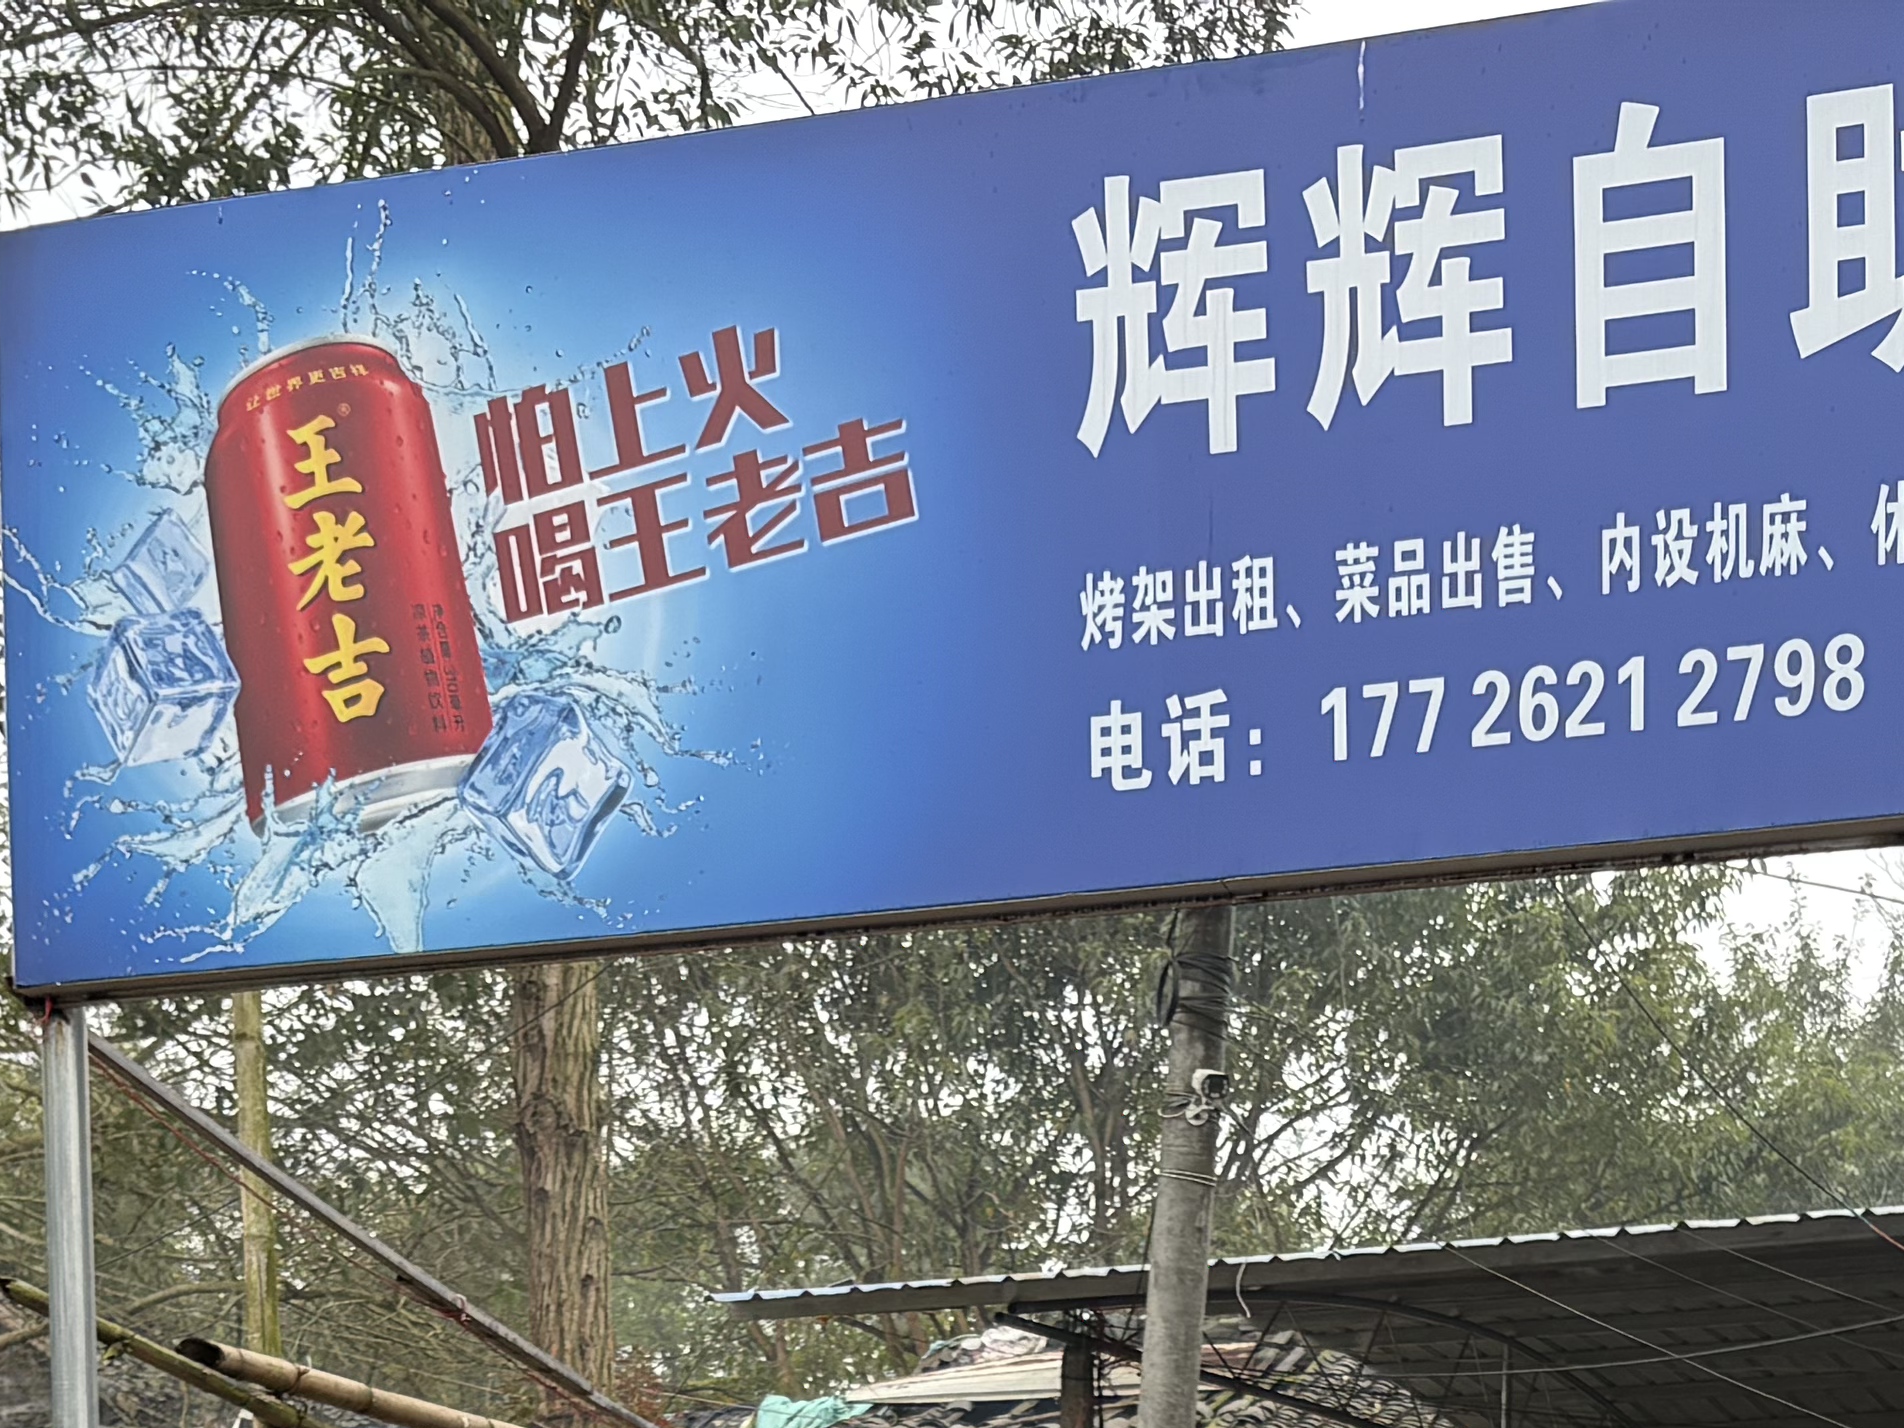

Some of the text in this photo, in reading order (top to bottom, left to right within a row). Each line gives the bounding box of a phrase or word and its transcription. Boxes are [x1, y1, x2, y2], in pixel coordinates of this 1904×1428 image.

[472, 324, 792, 501] 怕上火
[282, 413, 391, 723] 王老吉
[493, 417, 918, 624] 喝王老吉
[1319, 676, 1446, 762] 177
[1471, 655, 1647, 749] 2621
[1676, 633, 1866, 728] 2798
